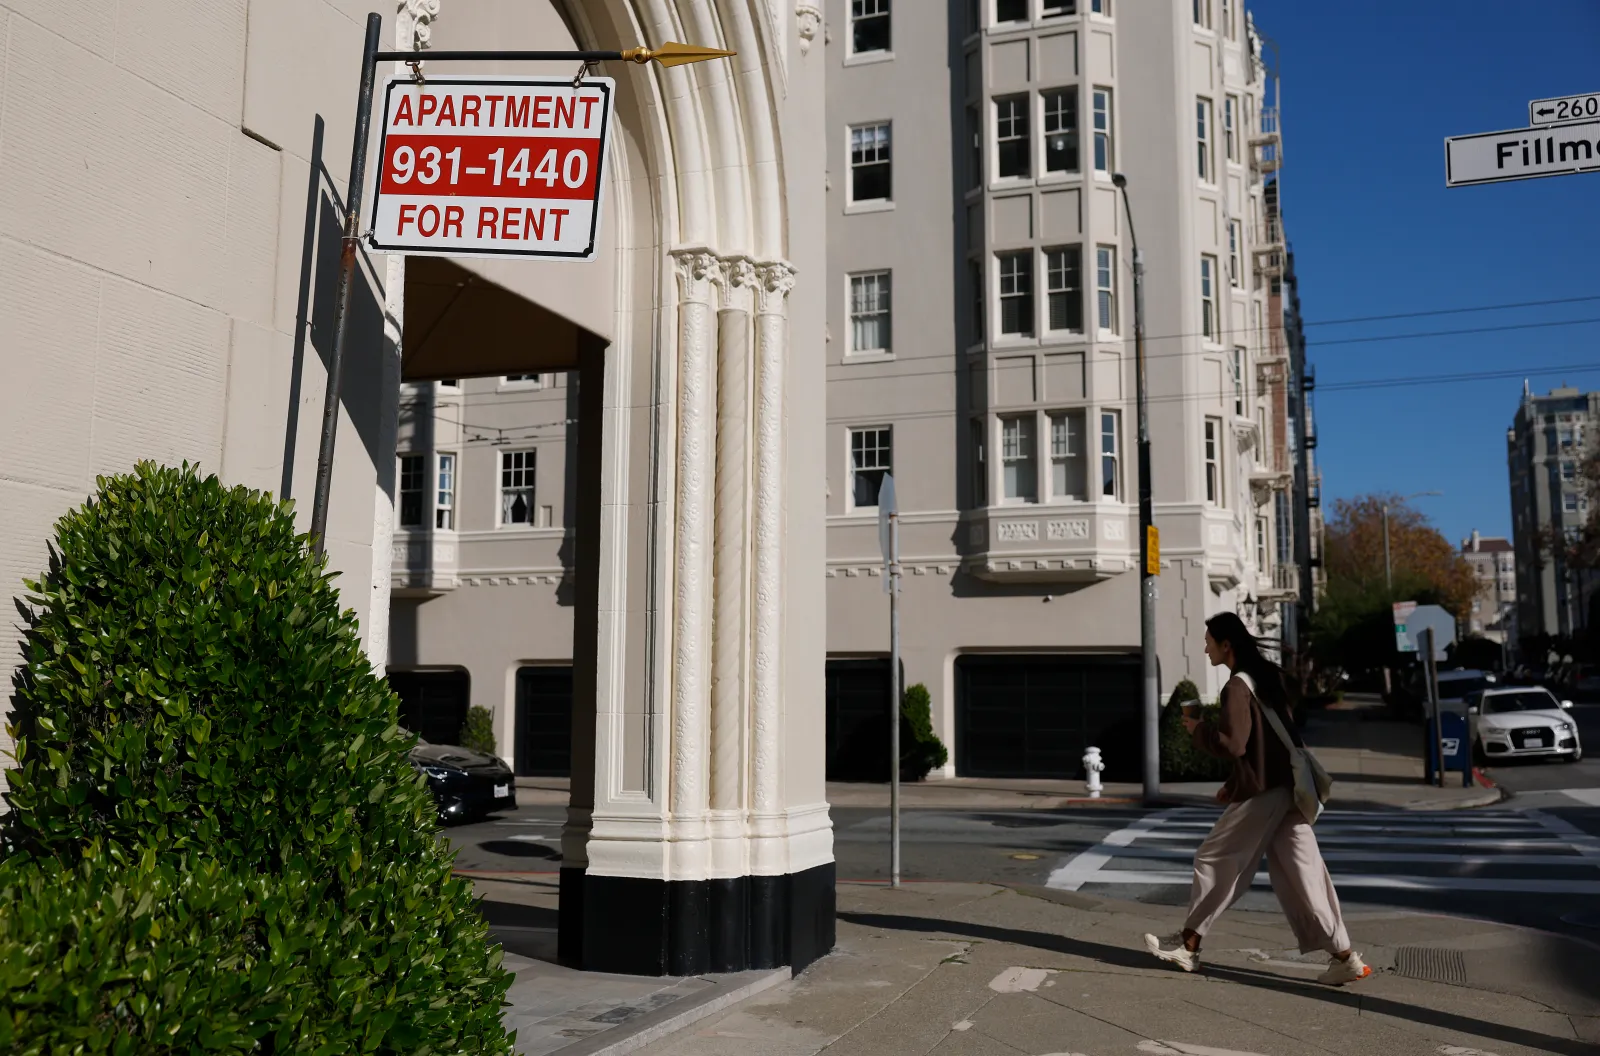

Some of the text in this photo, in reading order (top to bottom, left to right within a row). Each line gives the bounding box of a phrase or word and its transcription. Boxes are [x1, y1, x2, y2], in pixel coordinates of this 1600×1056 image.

[393, 94, 600, 130] APARTMENT
[391, 145, 588, 189] 931-1440
[1496, 136, 1600, 169] Fillm
[397, 204, 570, 241] FOR RENT
